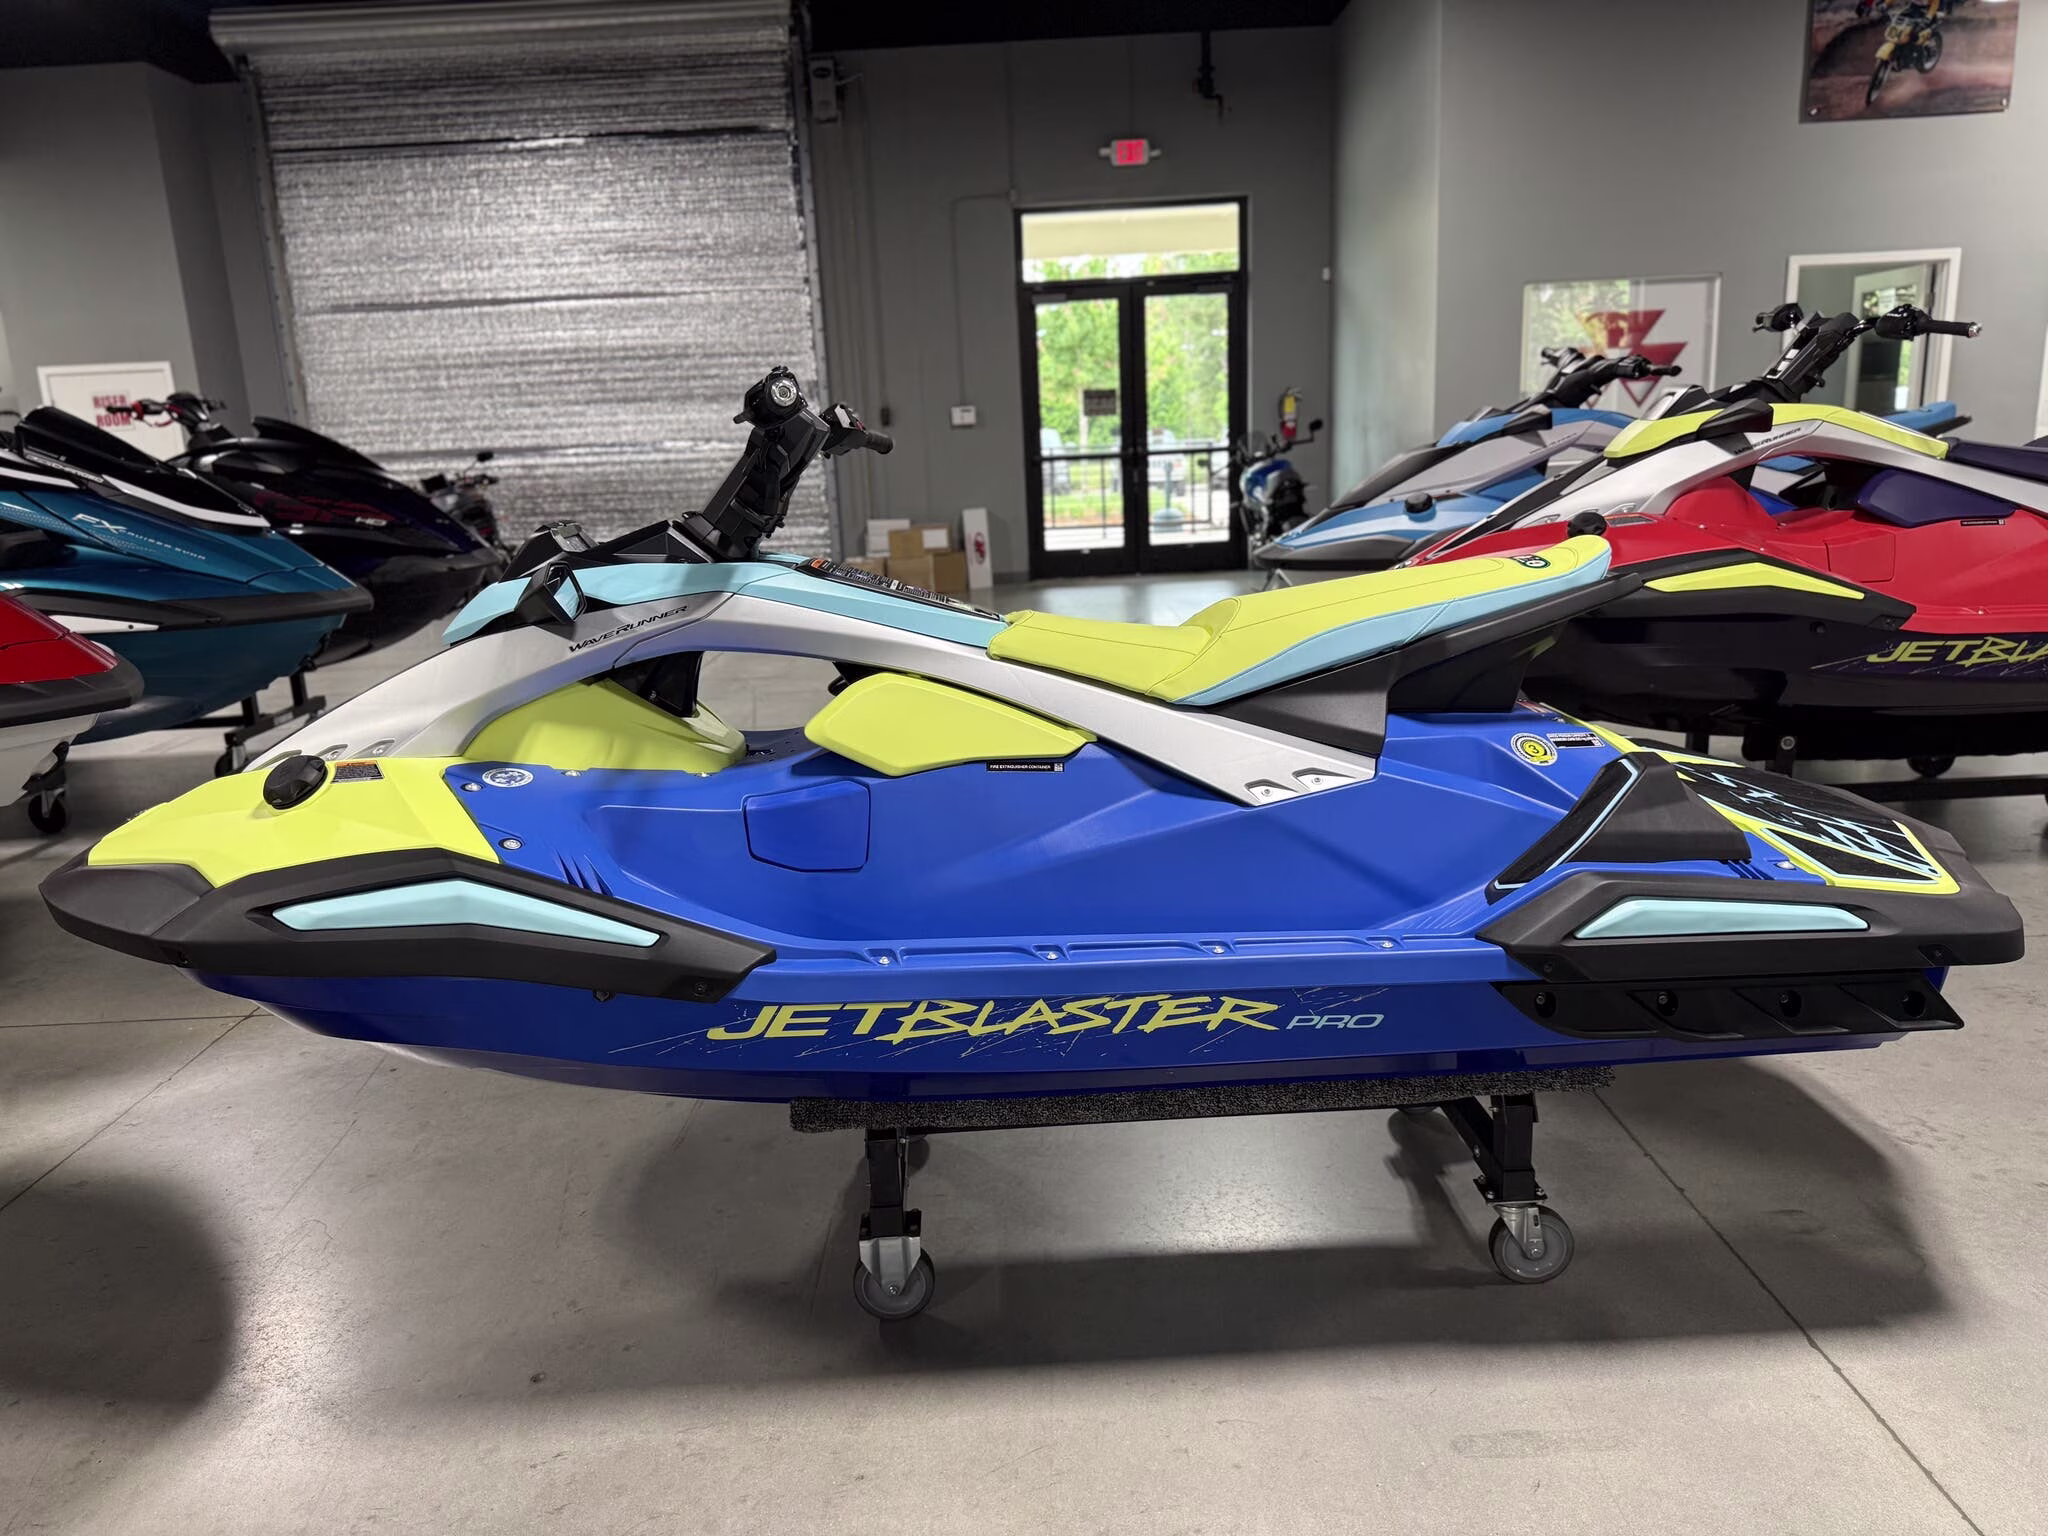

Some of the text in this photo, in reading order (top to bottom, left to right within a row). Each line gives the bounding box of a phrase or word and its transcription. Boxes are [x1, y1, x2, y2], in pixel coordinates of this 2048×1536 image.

[72, 513, 128, 535] FX
[569, 606, 687, 652] WAVERUNNER
[706, 994, 1384, 1045] JETBLASTER PRO
